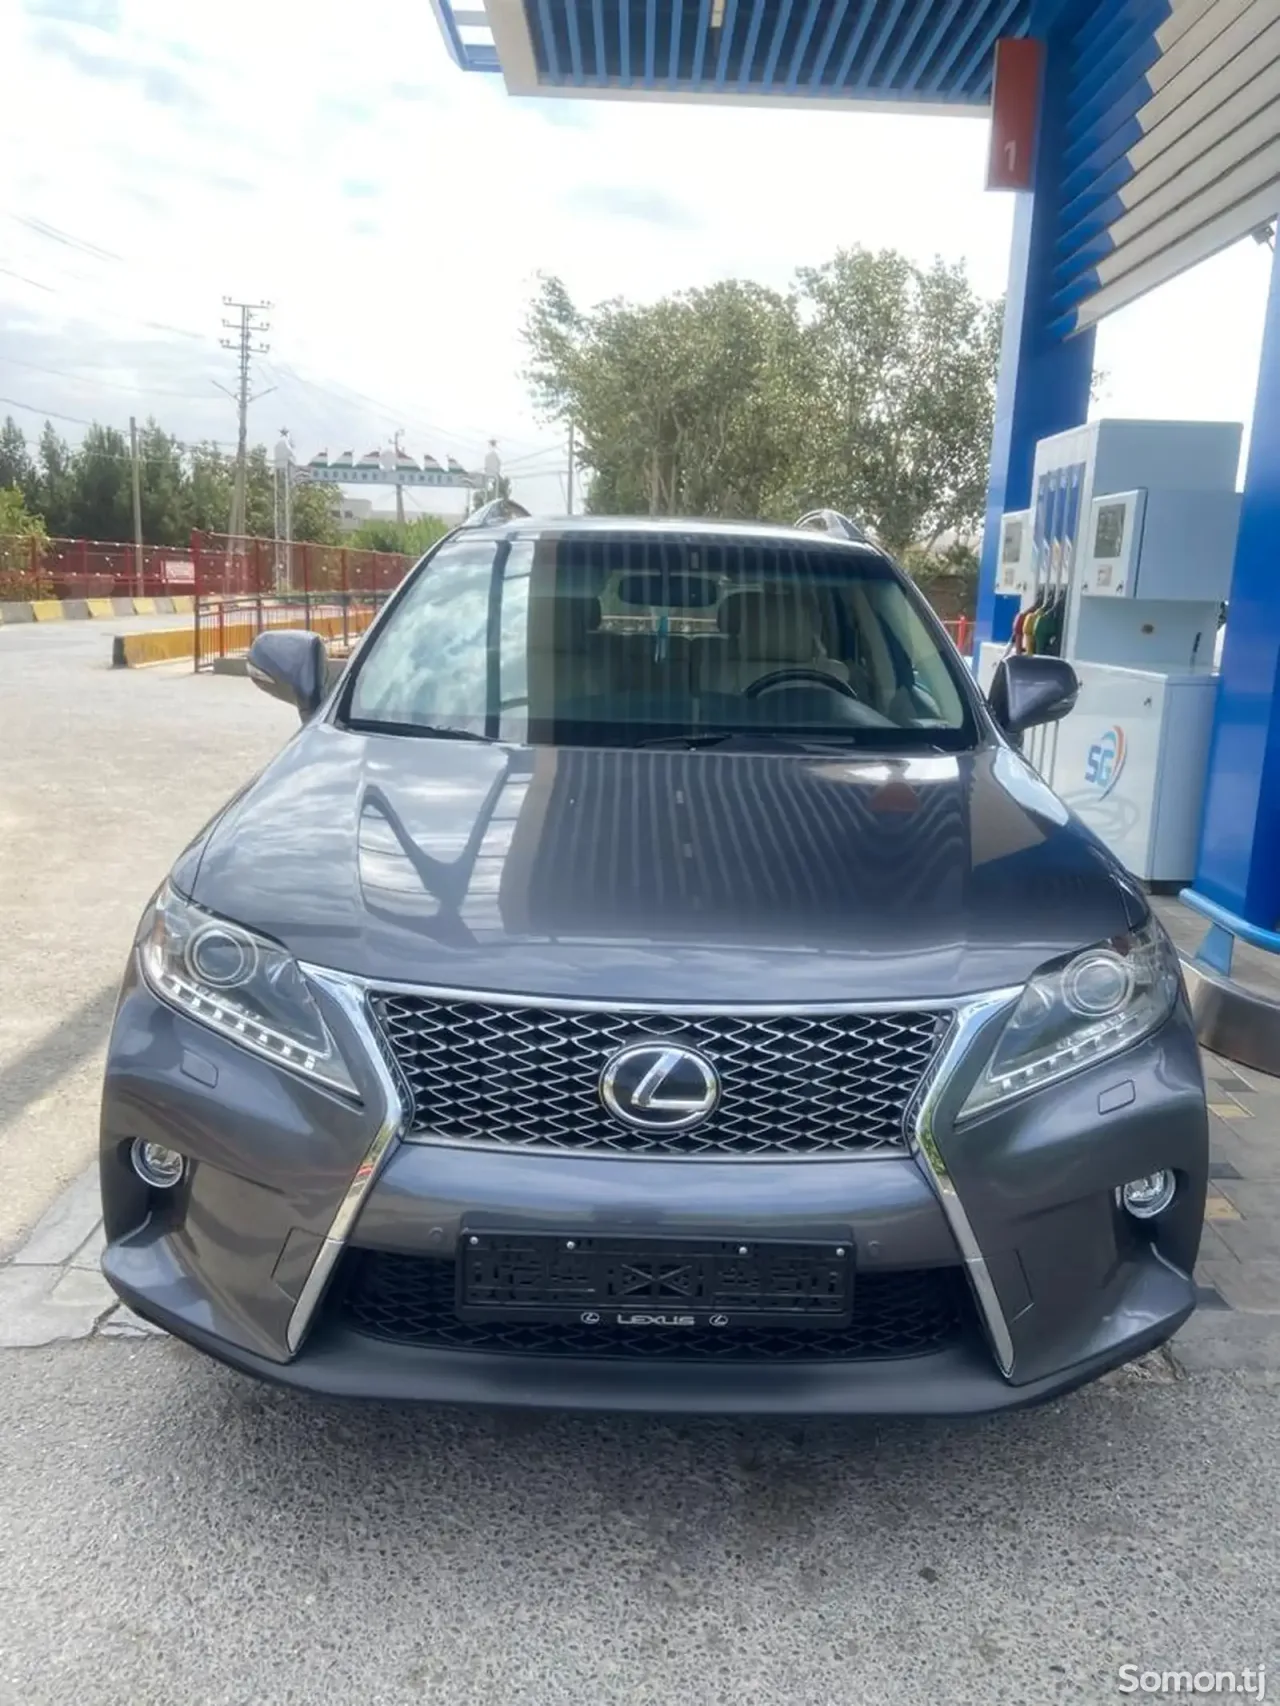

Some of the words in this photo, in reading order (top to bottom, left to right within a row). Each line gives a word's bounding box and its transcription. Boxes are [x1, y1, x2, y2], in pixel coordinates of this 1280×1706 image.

[1003, 139, 1017, 172] 1
[1084, 744, 1115, 788] SG
[617, 1313, 695, 1326] LEXUS
